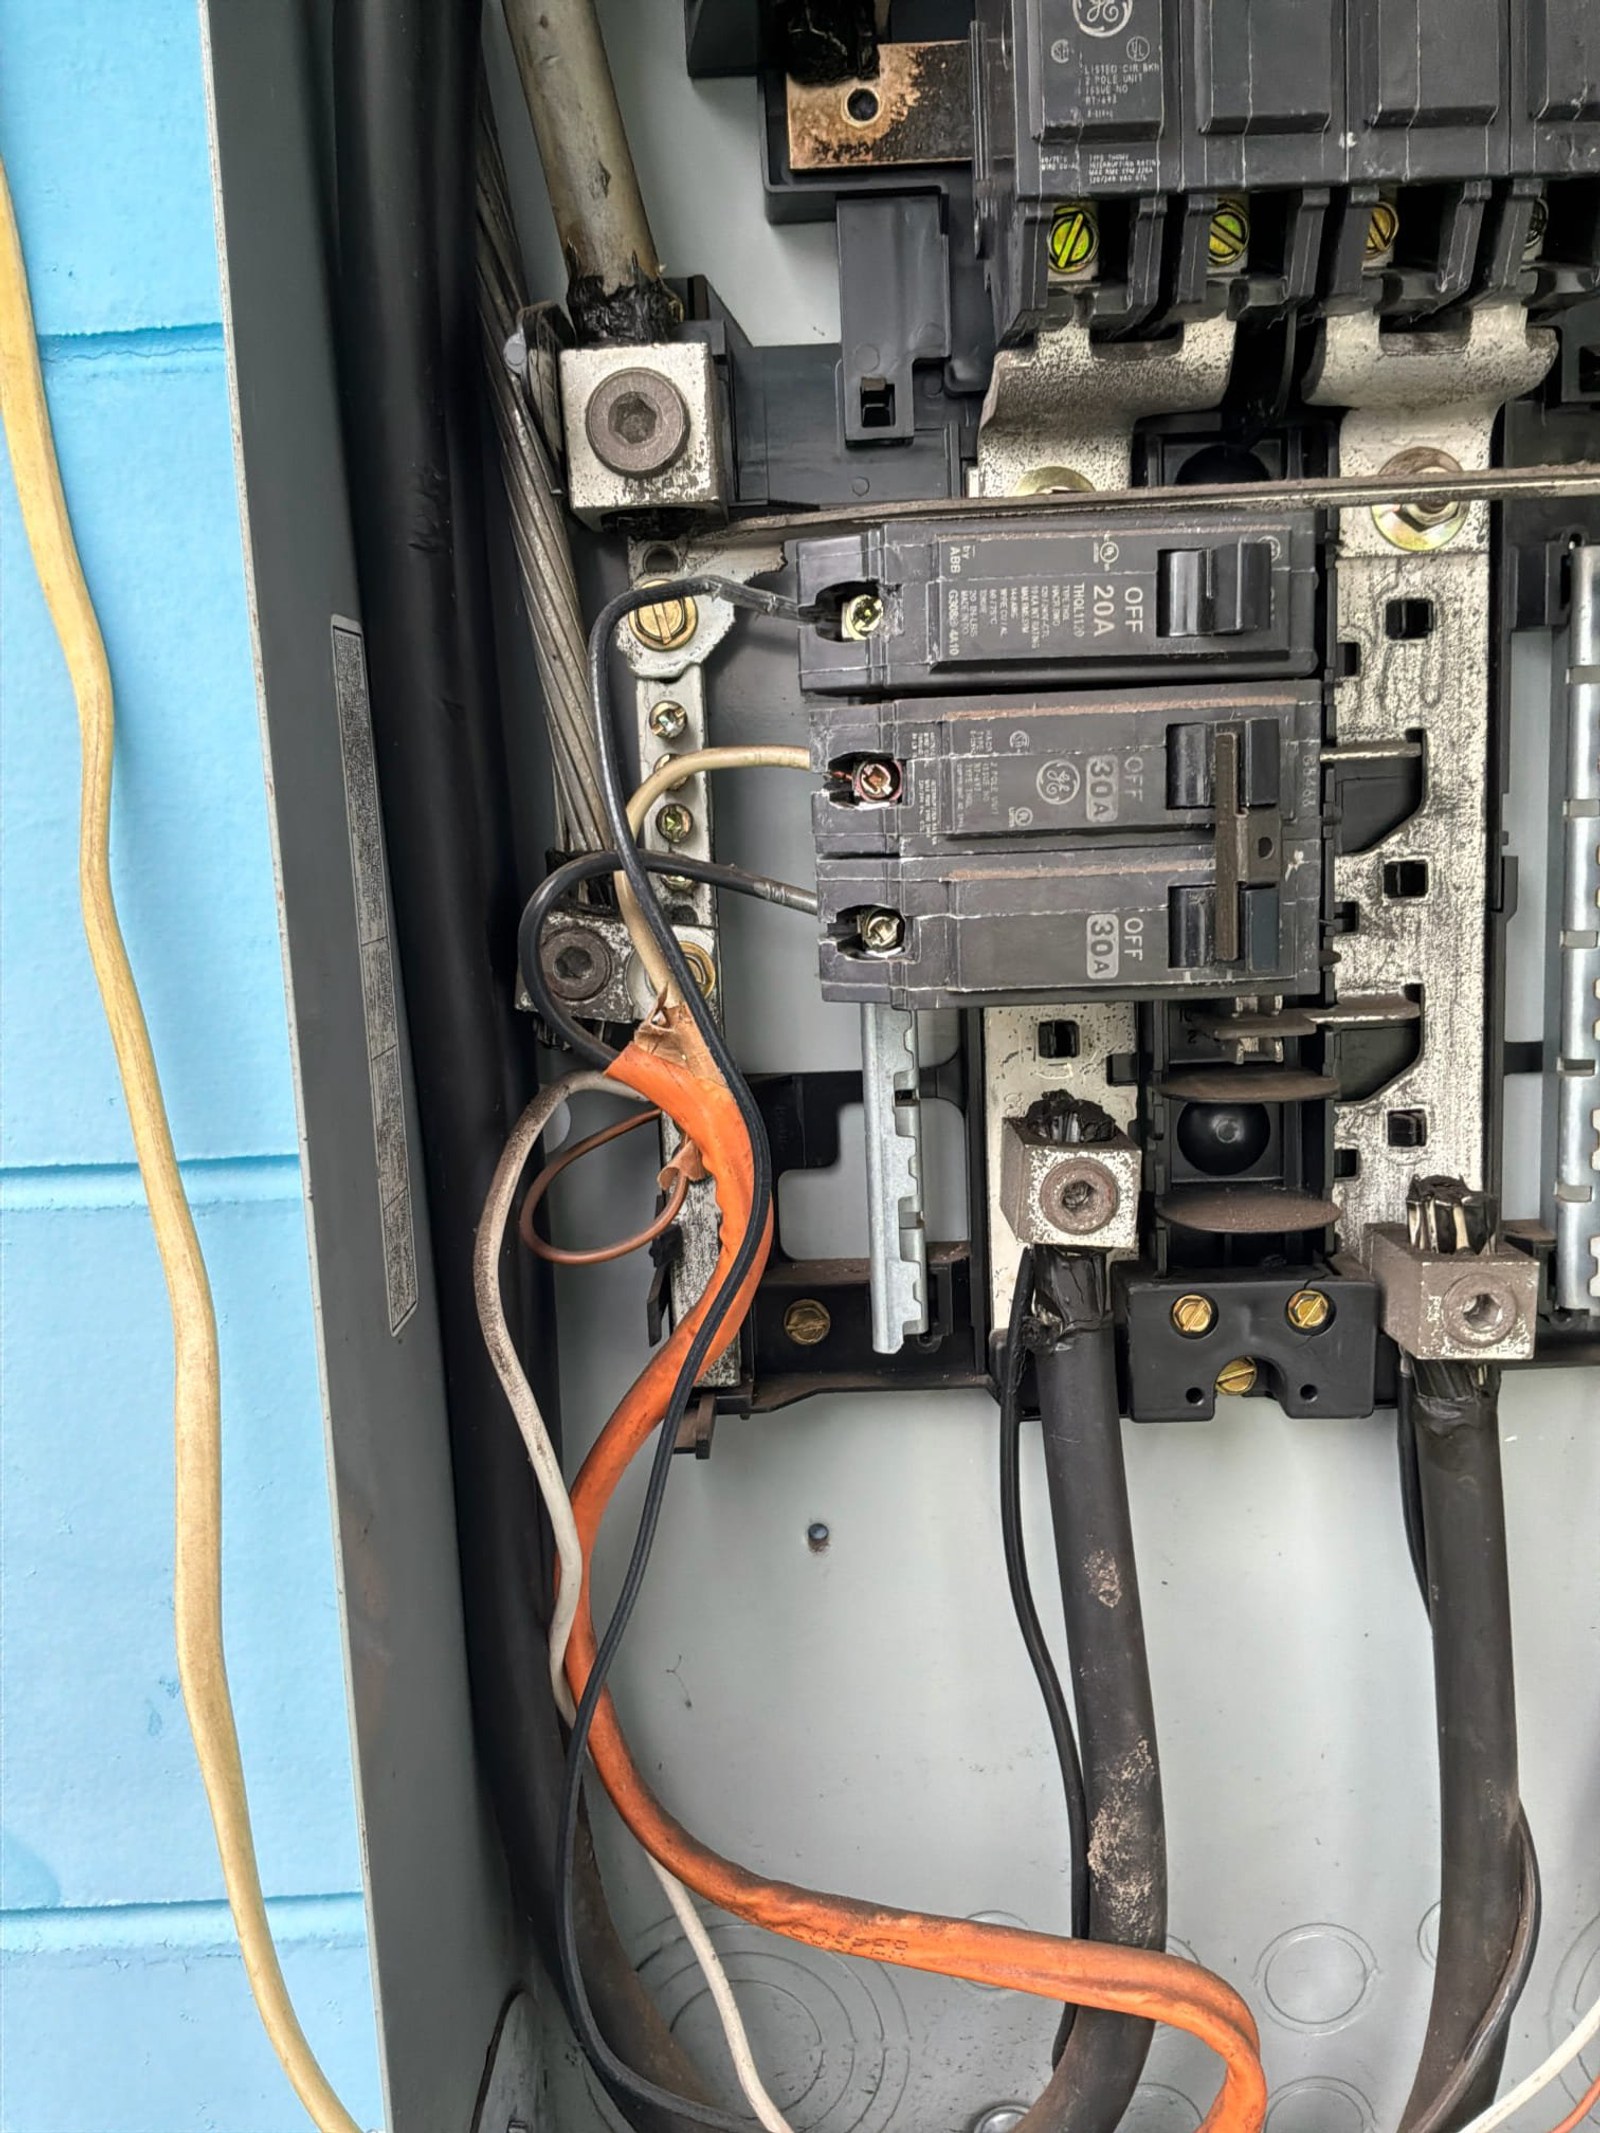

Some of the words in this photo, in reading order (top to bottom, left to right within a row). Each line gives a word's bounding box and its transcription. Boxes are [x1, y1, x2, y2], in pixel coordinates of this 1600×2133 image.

[1084, 64, 1118, 75] LISTED
[1085, 86, 1111, 96] ISSUE
[1115, 85, 1129, 94] NO
[1095, 75, 1120, 85] POLE
[1124, 73, 1143, 83] UNIT
[950, 546, 961, 573] ABB
[961, 545, 971, 559] by
[1073, 583, 1085, 638] THQL1120
[1093, 584, 1115, 638] 20A
[1124, 586, 1144, 634] OFF
[948, 629, 960, 656] 4A10
[1090, 760, 1114, 817] 30A
[1124, 756, 1144, 802] OFF
[1090, 920, 1114, 974] 30A
[1124, 917, 1144, 961] OFF
